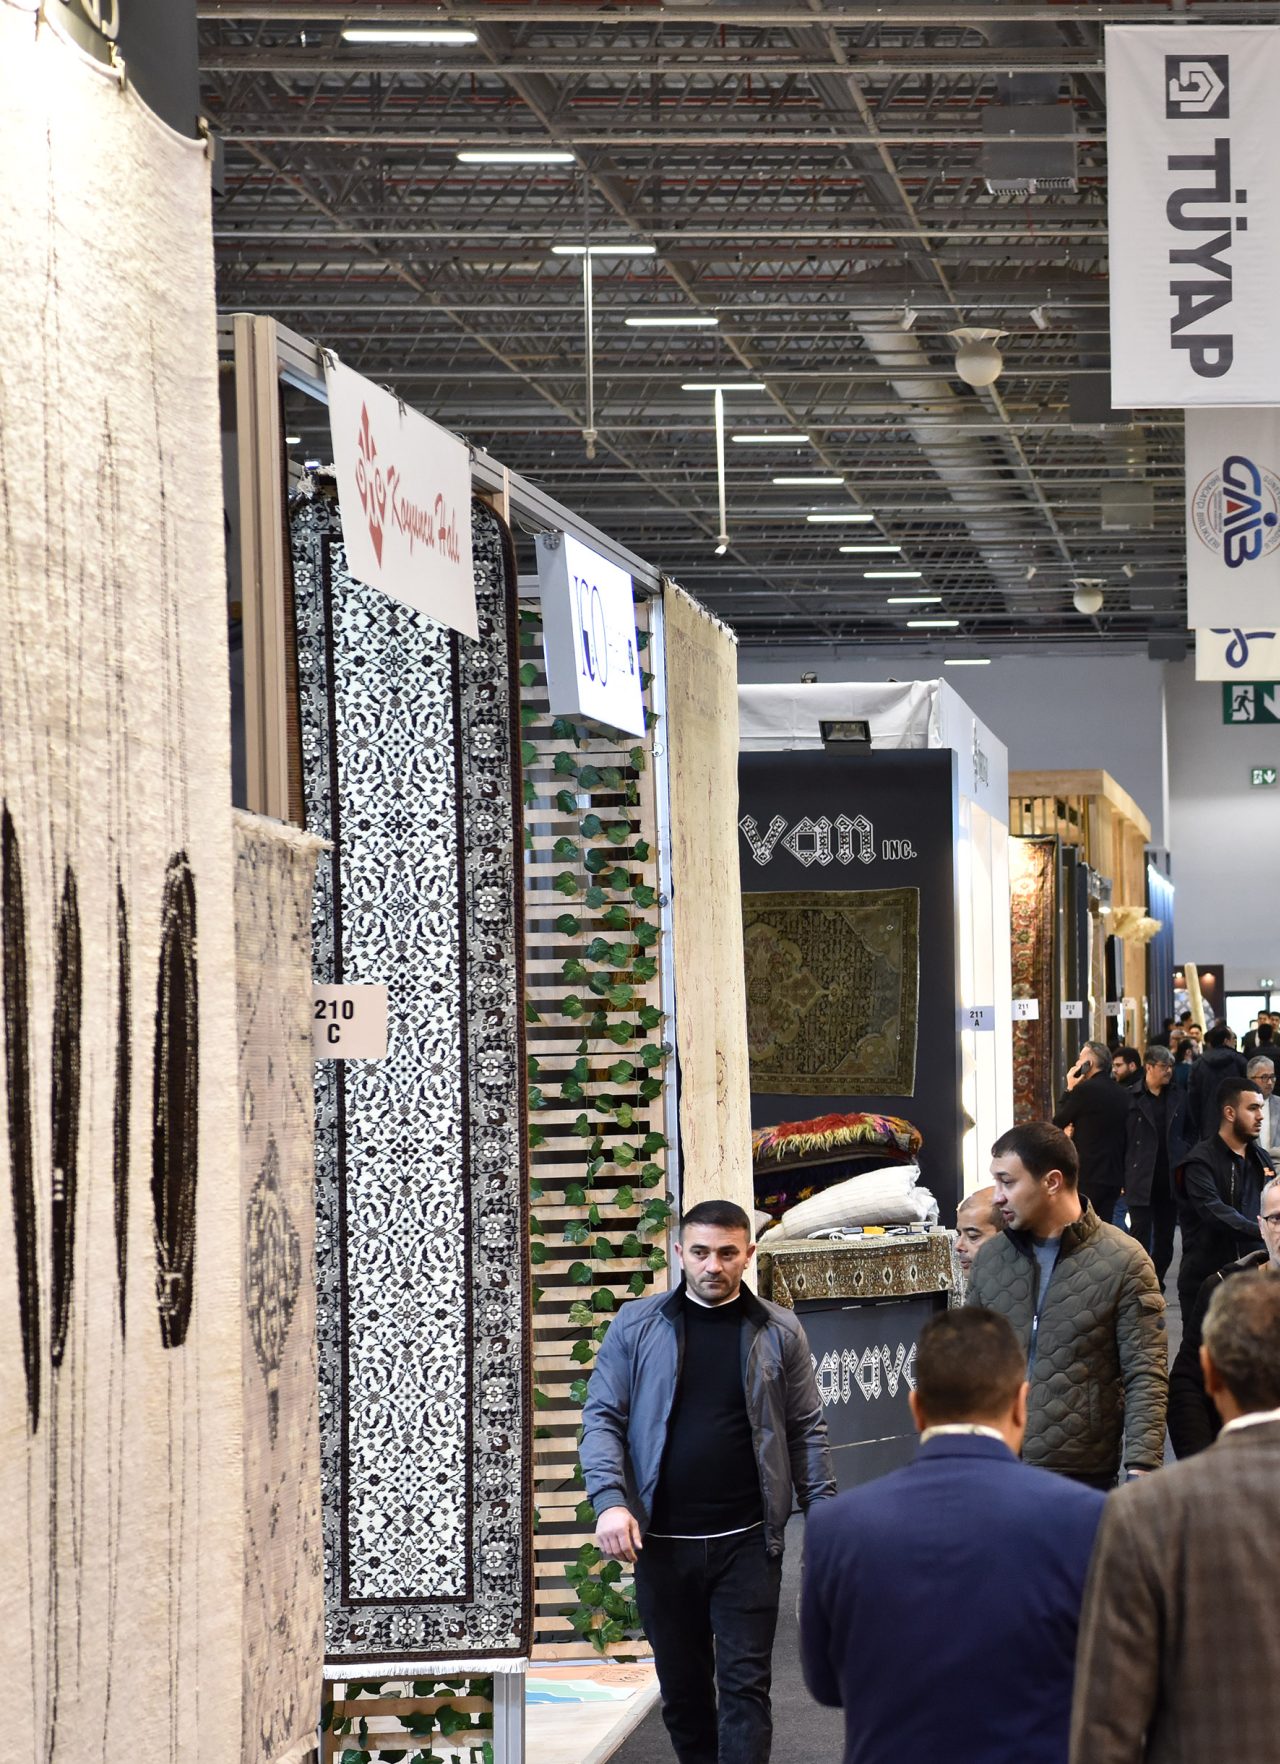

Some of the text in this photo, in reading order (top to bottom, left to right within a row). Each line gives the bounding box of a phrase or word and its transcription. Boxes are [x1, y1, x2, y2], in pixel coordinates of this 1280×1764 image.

[1166, 138, 1248, 379] TÜYAP
[882, 839, 917, 860] INC.
[314, 999, 354, 1020] 210
[970, 1010, 983, 1018] 211
[327, 1023, 341, 1044] C
[974, 1019, 980, 1027] A
